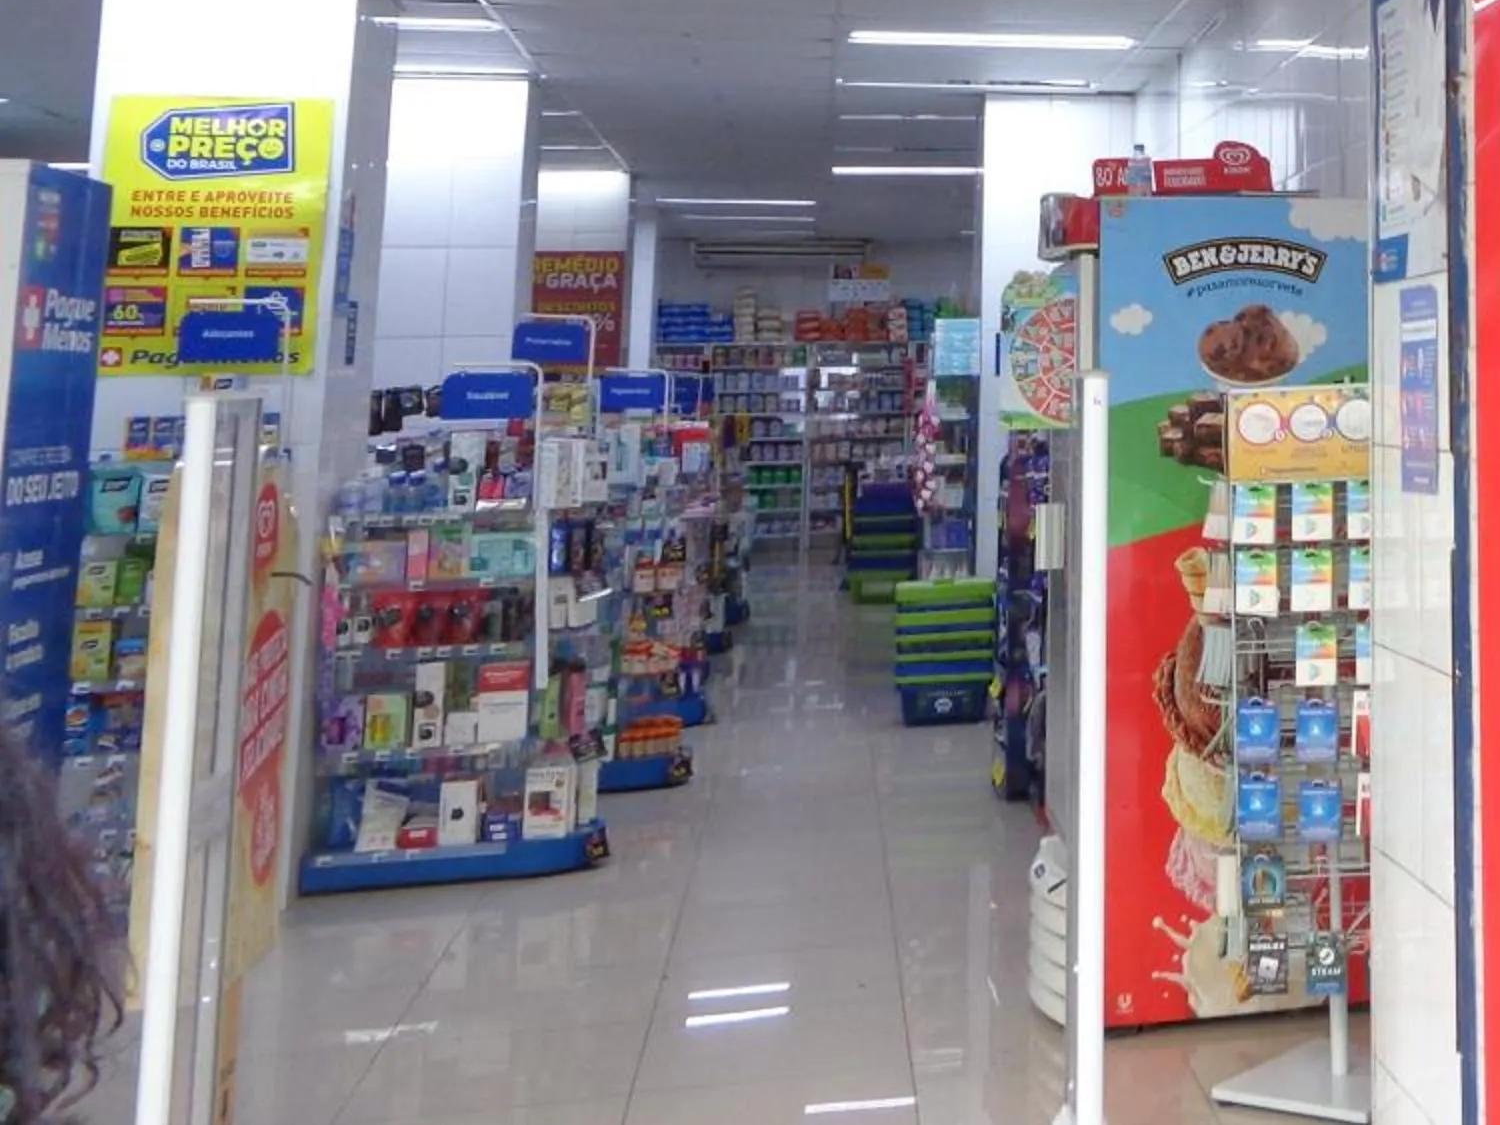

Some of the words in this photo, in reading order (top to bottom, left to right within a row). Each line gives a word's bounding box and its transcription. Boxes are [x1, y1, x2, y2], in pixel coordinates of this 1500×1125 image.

[170, 117, 286, 137] MELHOR
[168, 135, 285, 166] PREÇO
[166, 159, 187, 170] DO
[189, 159, 237, 170] BRASIL
[132, 190, 187, 203] ENTRE
[191, 191, 201, 203] E
[204, 191, 294, 204] APROVEITE
[131, 206, 194, 218] NOSSOS
[199, 203, 294, 219] BENEFÍCIOS
[546, 273, 617, 294] GRAÇA
[45, 288, 96, 328] Pague
[42, 322, 93, 353] Menos
[6, 476, 24, 507] DO
[24, 474, 49, 504] SEU
[48, 470, 79, 499] JEITO
